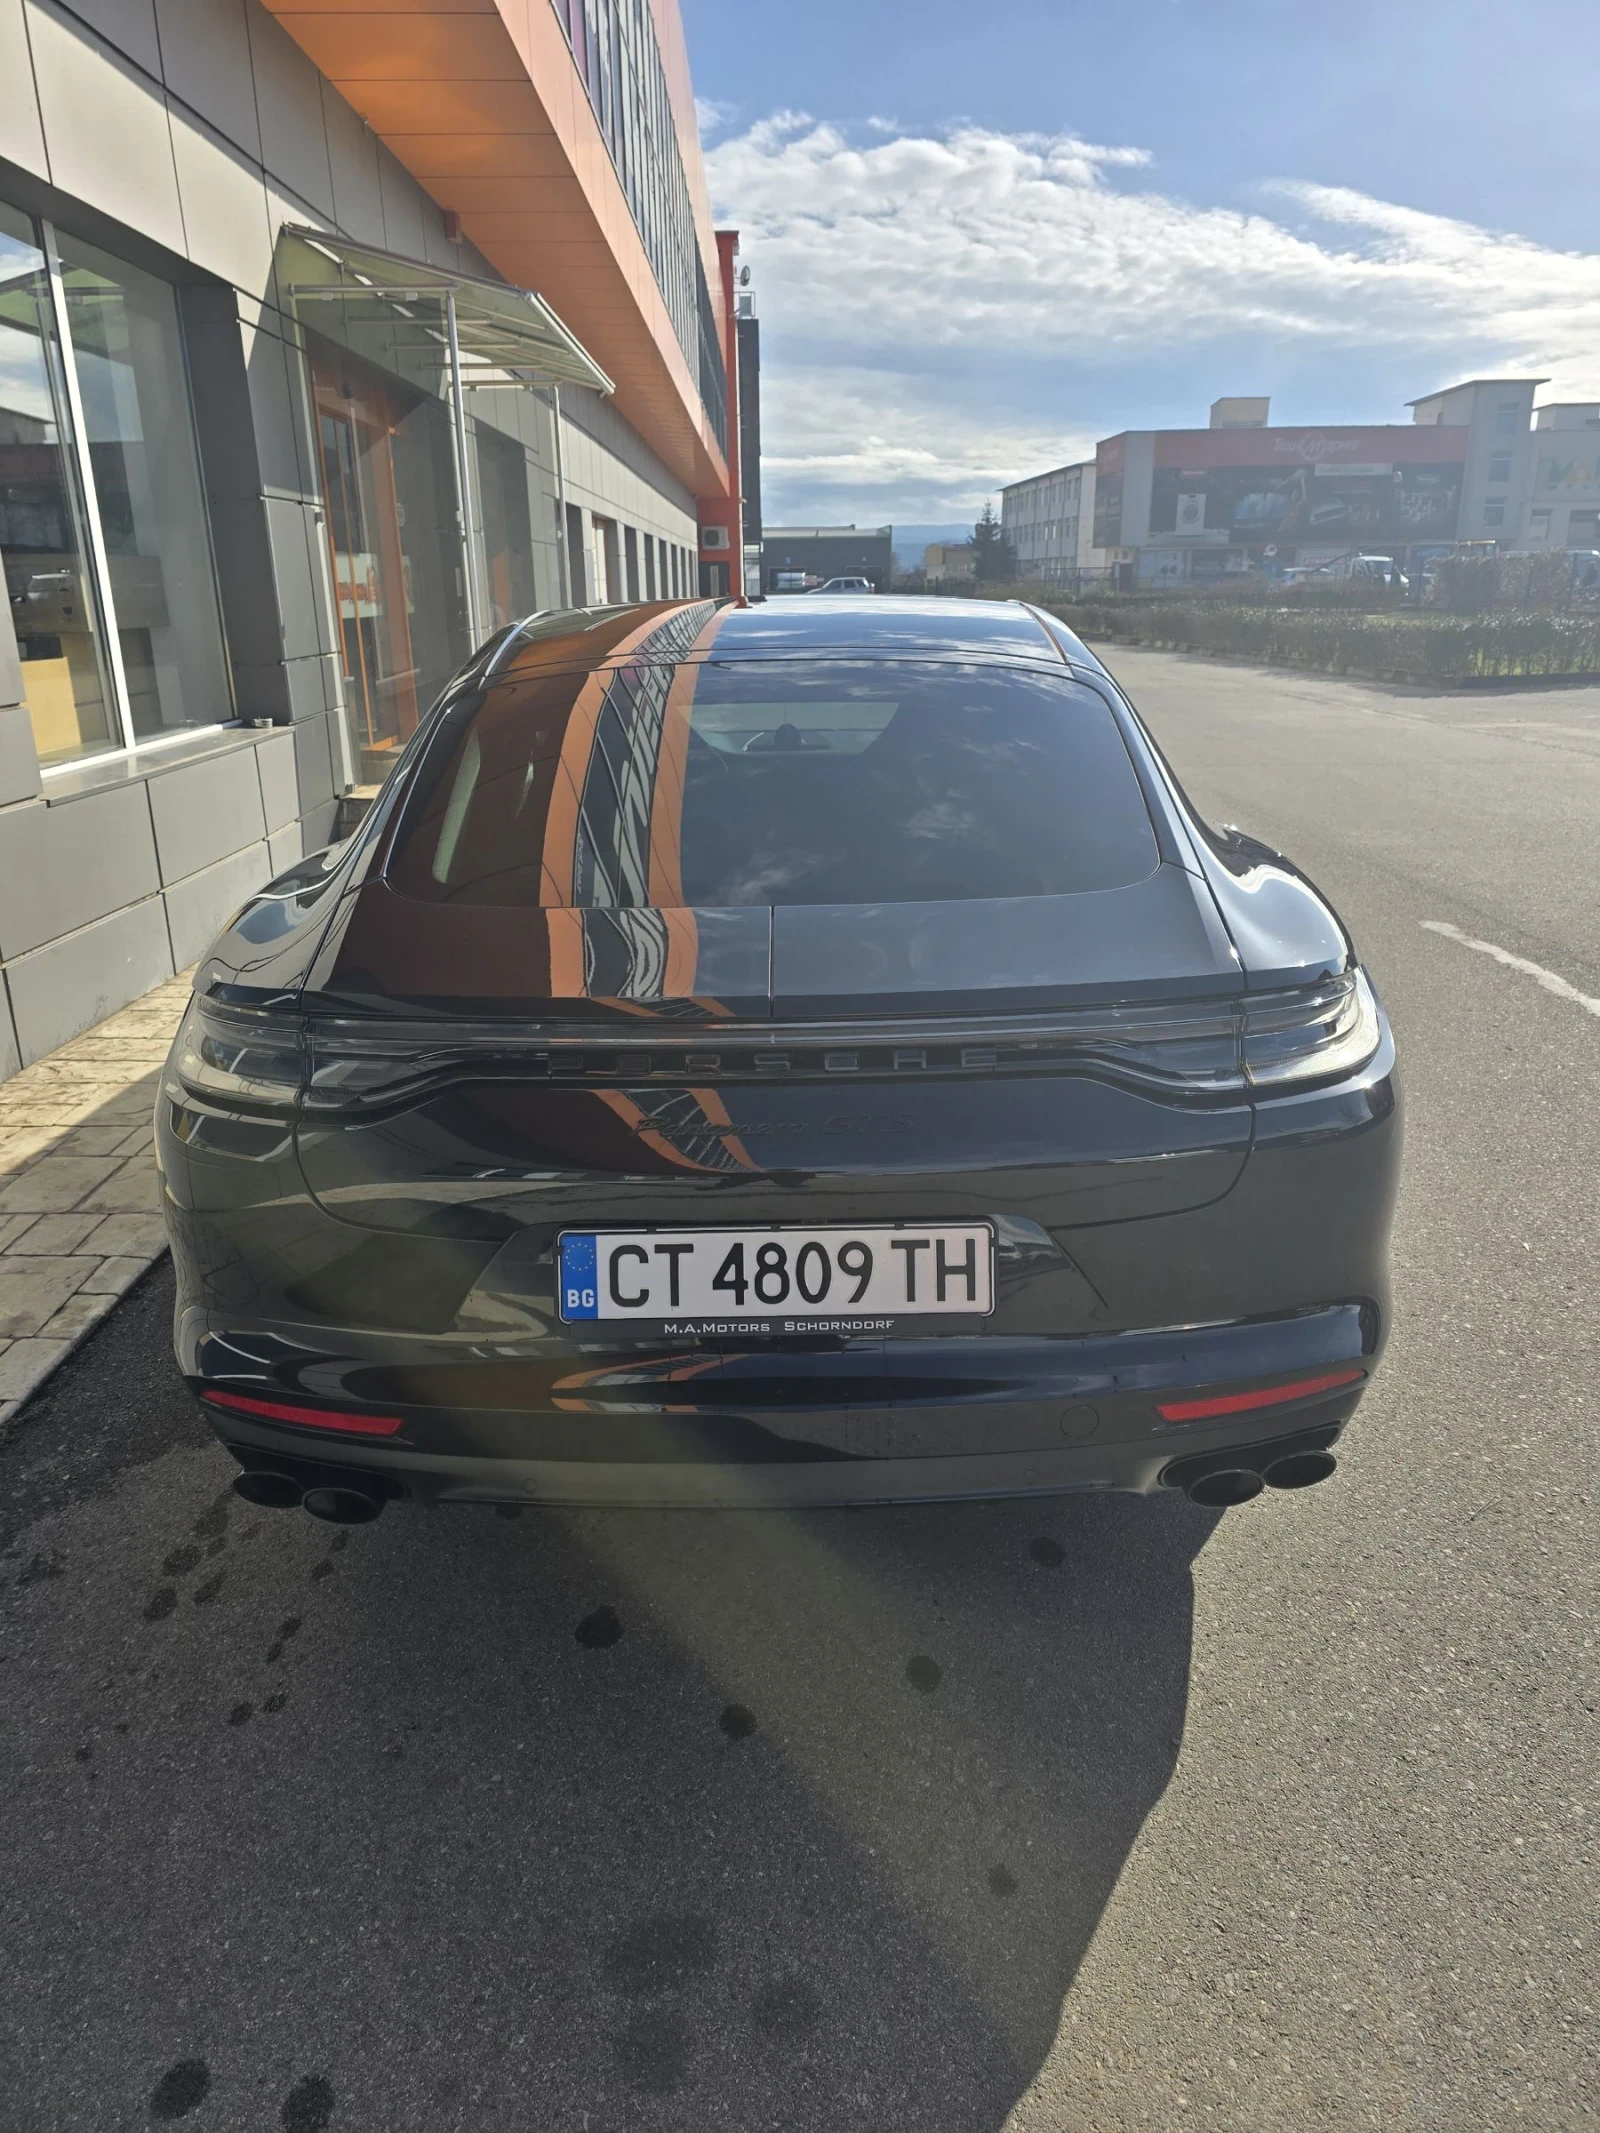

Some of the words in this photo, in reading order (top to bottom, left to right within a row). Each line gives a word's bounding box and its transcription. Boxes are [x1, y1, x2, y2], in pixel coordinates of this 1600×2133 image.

[548, 1048, 998, 1073] PORSCHE
[630, 1116, 809, 1138] Panamera
[825, 1113, 916, 1134] GTS
[609, 1244, 694, 1308] CT
[711, 1241, 874, 1306] 4809
[891, 1239, 976, 1302] TH
[567, 1290, 595, 1308] BG
